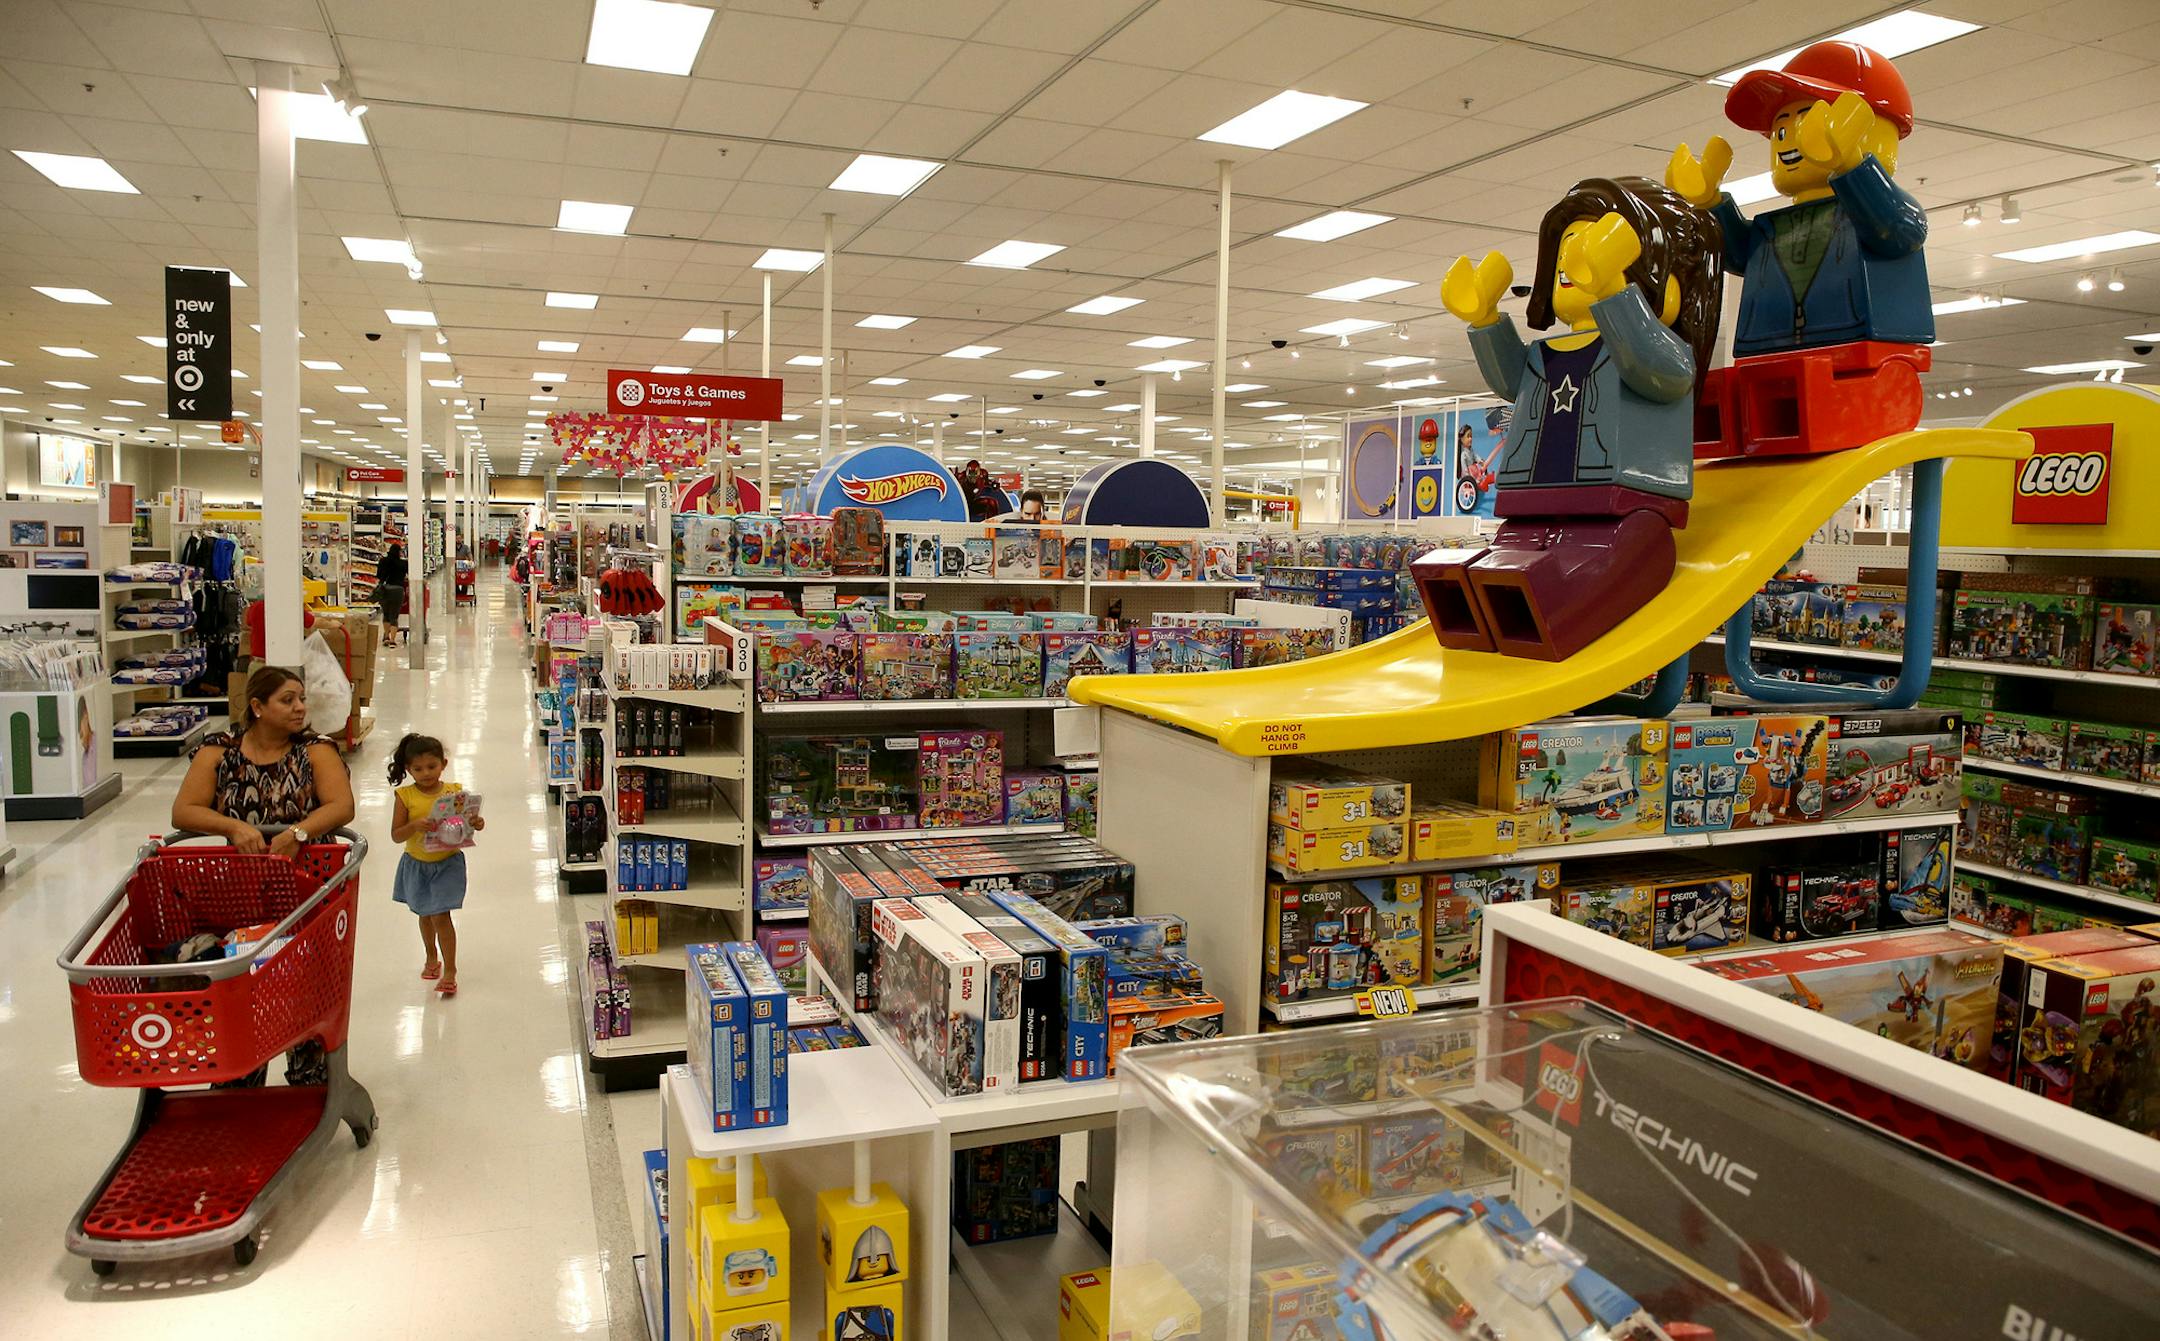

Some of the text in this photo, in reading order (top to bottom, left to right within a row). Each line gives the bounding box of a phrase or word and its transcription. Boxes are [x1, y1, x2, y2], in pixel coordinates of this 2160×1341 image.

[175, 299, 214, 313] new
[175, 313, 190, 329] &
[175, 330, 215, 349] only
[176, 347, 195, 362] at
[649, 383, 746, 399] Toys & Games
[648, 398, 681, 406] Juguetes
[687, 400, 712, 408] juegos
[2018, 452, 2107, 496] LEGO
[1282, 724, 1302, 732] NOT
[1843, 720, 1881, 731] SPEED
[1261, 733, 1306, 742] HANG OR
[1521, 736, 1583, 749] LEGO CREATOR
[1675, 733, 1691, 742] LEGO
[1268, 743, 1298, 751] CLIMB
[1519, 763, 1537, 772] 9-14
[1904, 832, 1936, 841] TECHNIC
[965, 877, 1013, 891] STAR
[1454, 879, 1487, 889] CREATOR
[1804, 876, 1839, 885] TECHNIC
[1284, 891, 1342, 904] LEGO CREATOR
[1670, 891, 1698, 902] CREATOR
[1096, 935, 1118, 945] CITY
[779, 944, 794, 952] LEGO
[1117, 981, 1140, 992] CITY
[1372, 989, 1408, 1015] NEW!
[2089, 994, 2107, 1005] LEGO
[1026, 1007, 1035, 1077] LEGO TECHNIC
[1075, 1035, 1084, 1057] CITY
[1538, 1061, 1758, 1196] LEGO TECHNIC
[1076, 1276, 1095, 1285] LEGO
[1279, 1300, 1298, 1312] LEGO
